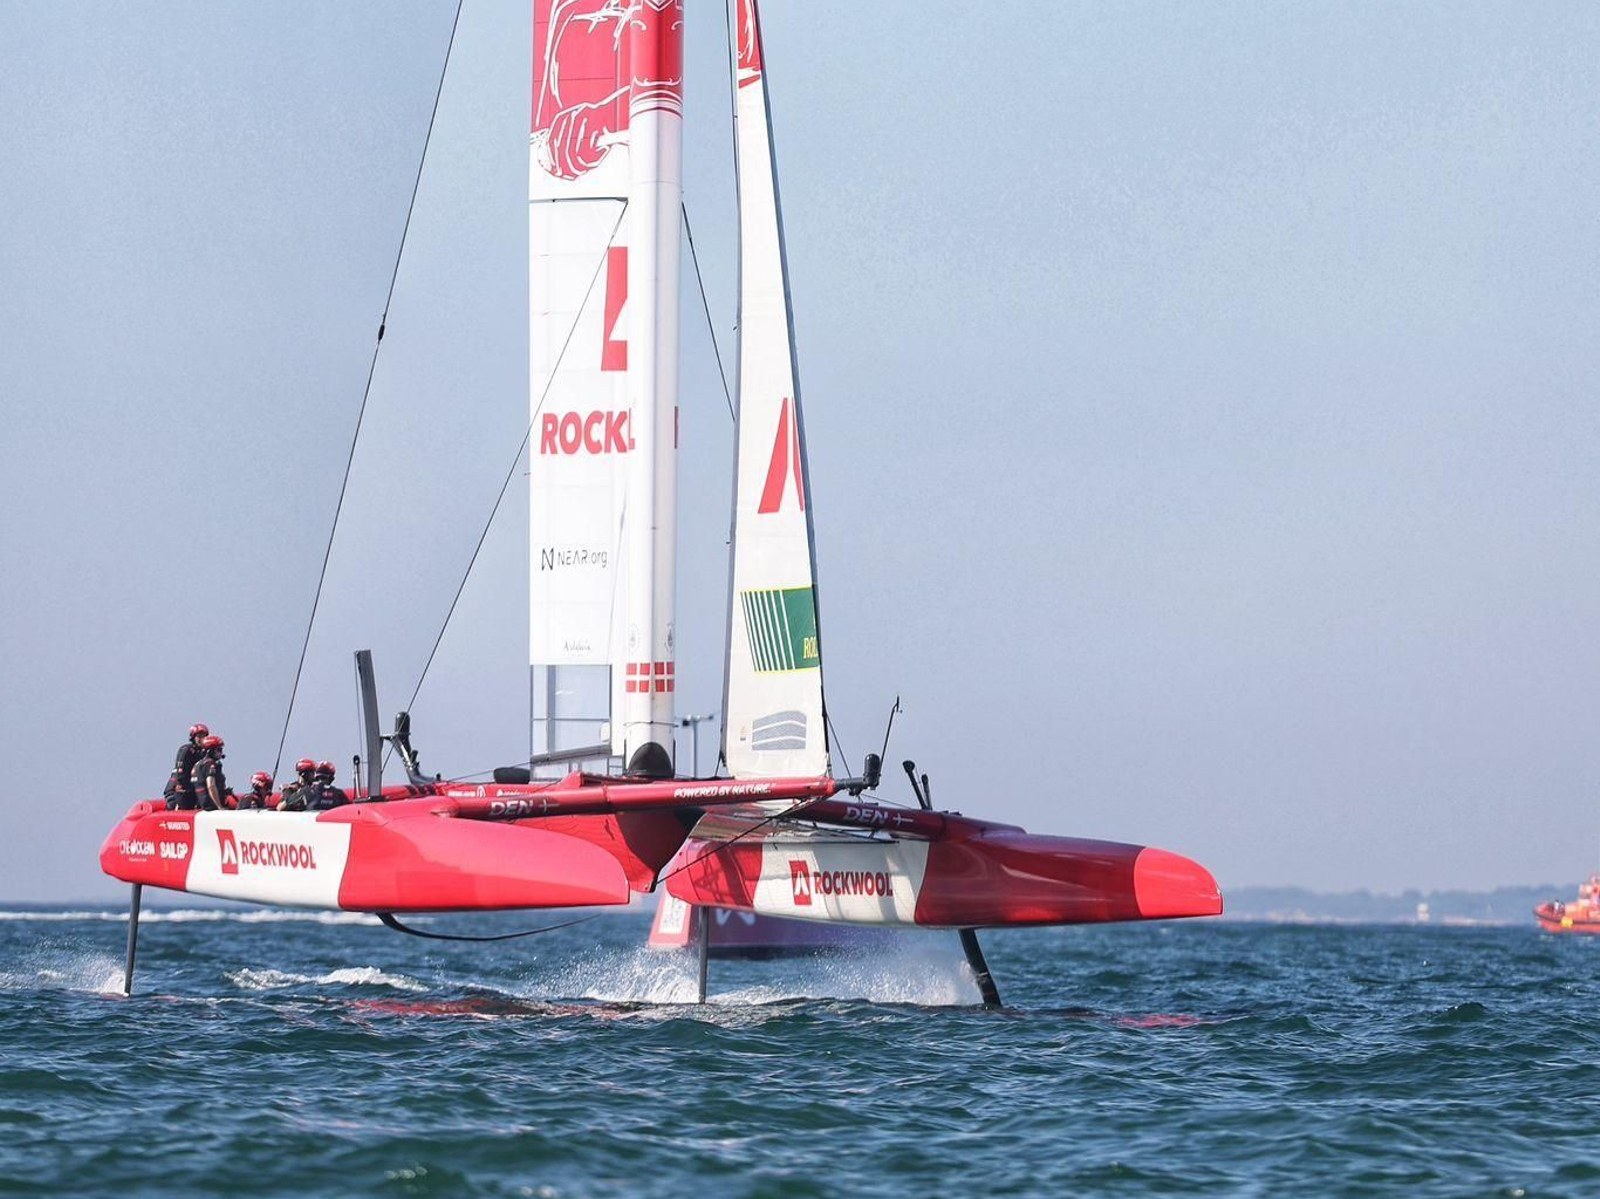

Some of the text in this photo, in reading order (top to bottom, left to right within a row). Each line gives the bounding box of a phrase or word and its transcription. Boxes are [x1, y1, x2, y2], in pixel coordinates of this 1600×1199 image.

[673, 786, 718, 799] POWERED
[719, 785, 733, 797] BY
[490, 800, 534, 817] DEN
[843, 806, 889, 825] DEN
[240, 841, 317, 870] ROCKWOOL
[813, 871, 894, 898] ROCKWOOL
